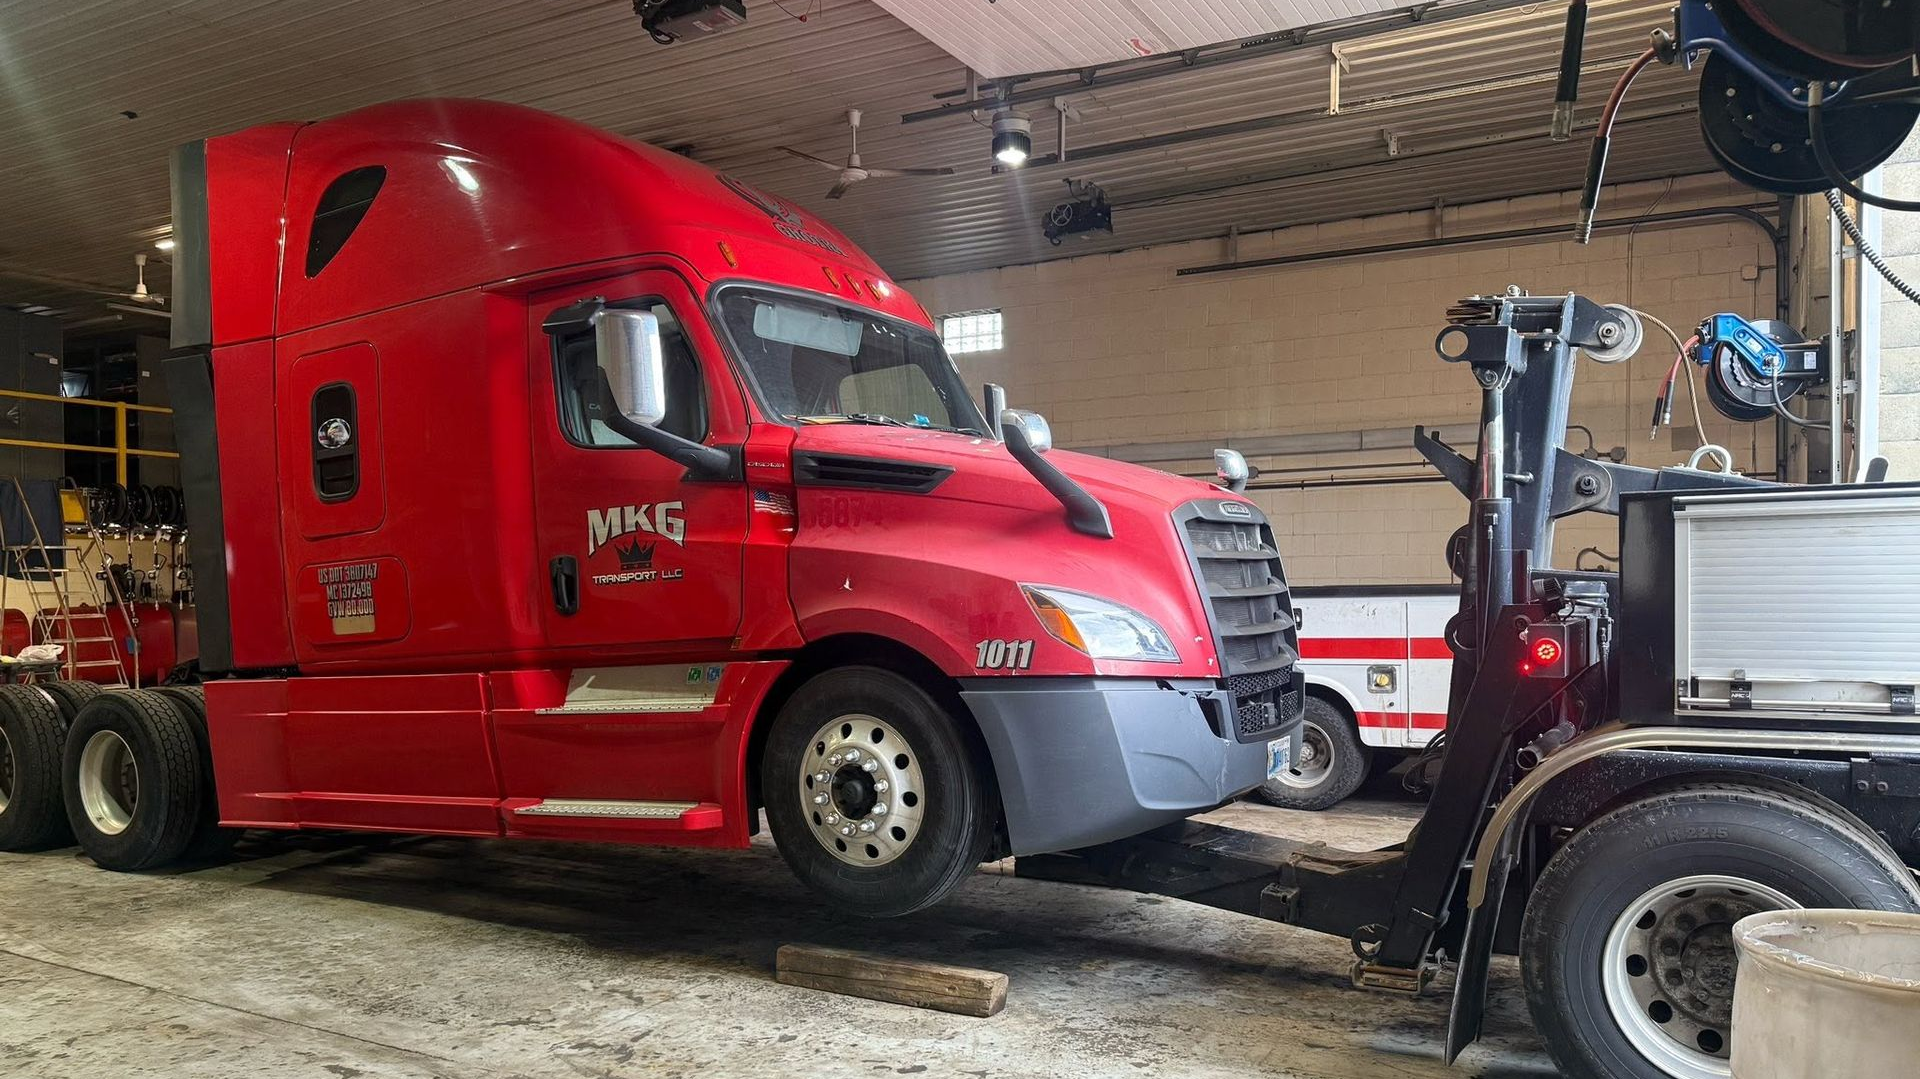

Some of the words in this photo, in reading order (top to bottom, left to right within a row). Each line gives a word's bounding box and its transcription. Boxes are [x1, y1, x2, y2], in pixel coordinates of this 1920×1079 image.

[586, 500, 686, 557] MKG
[318, 568, 328, 584] US
[328, 566, 343, 582] DOT
[592, 570, 657, 585] TRANSPORT
[662, 568, 683, 580] LLC
[326, 584, 338, 600] MC
[328, 601, 345, 617] GVW
[975, 638, 1034, 669] 1011
